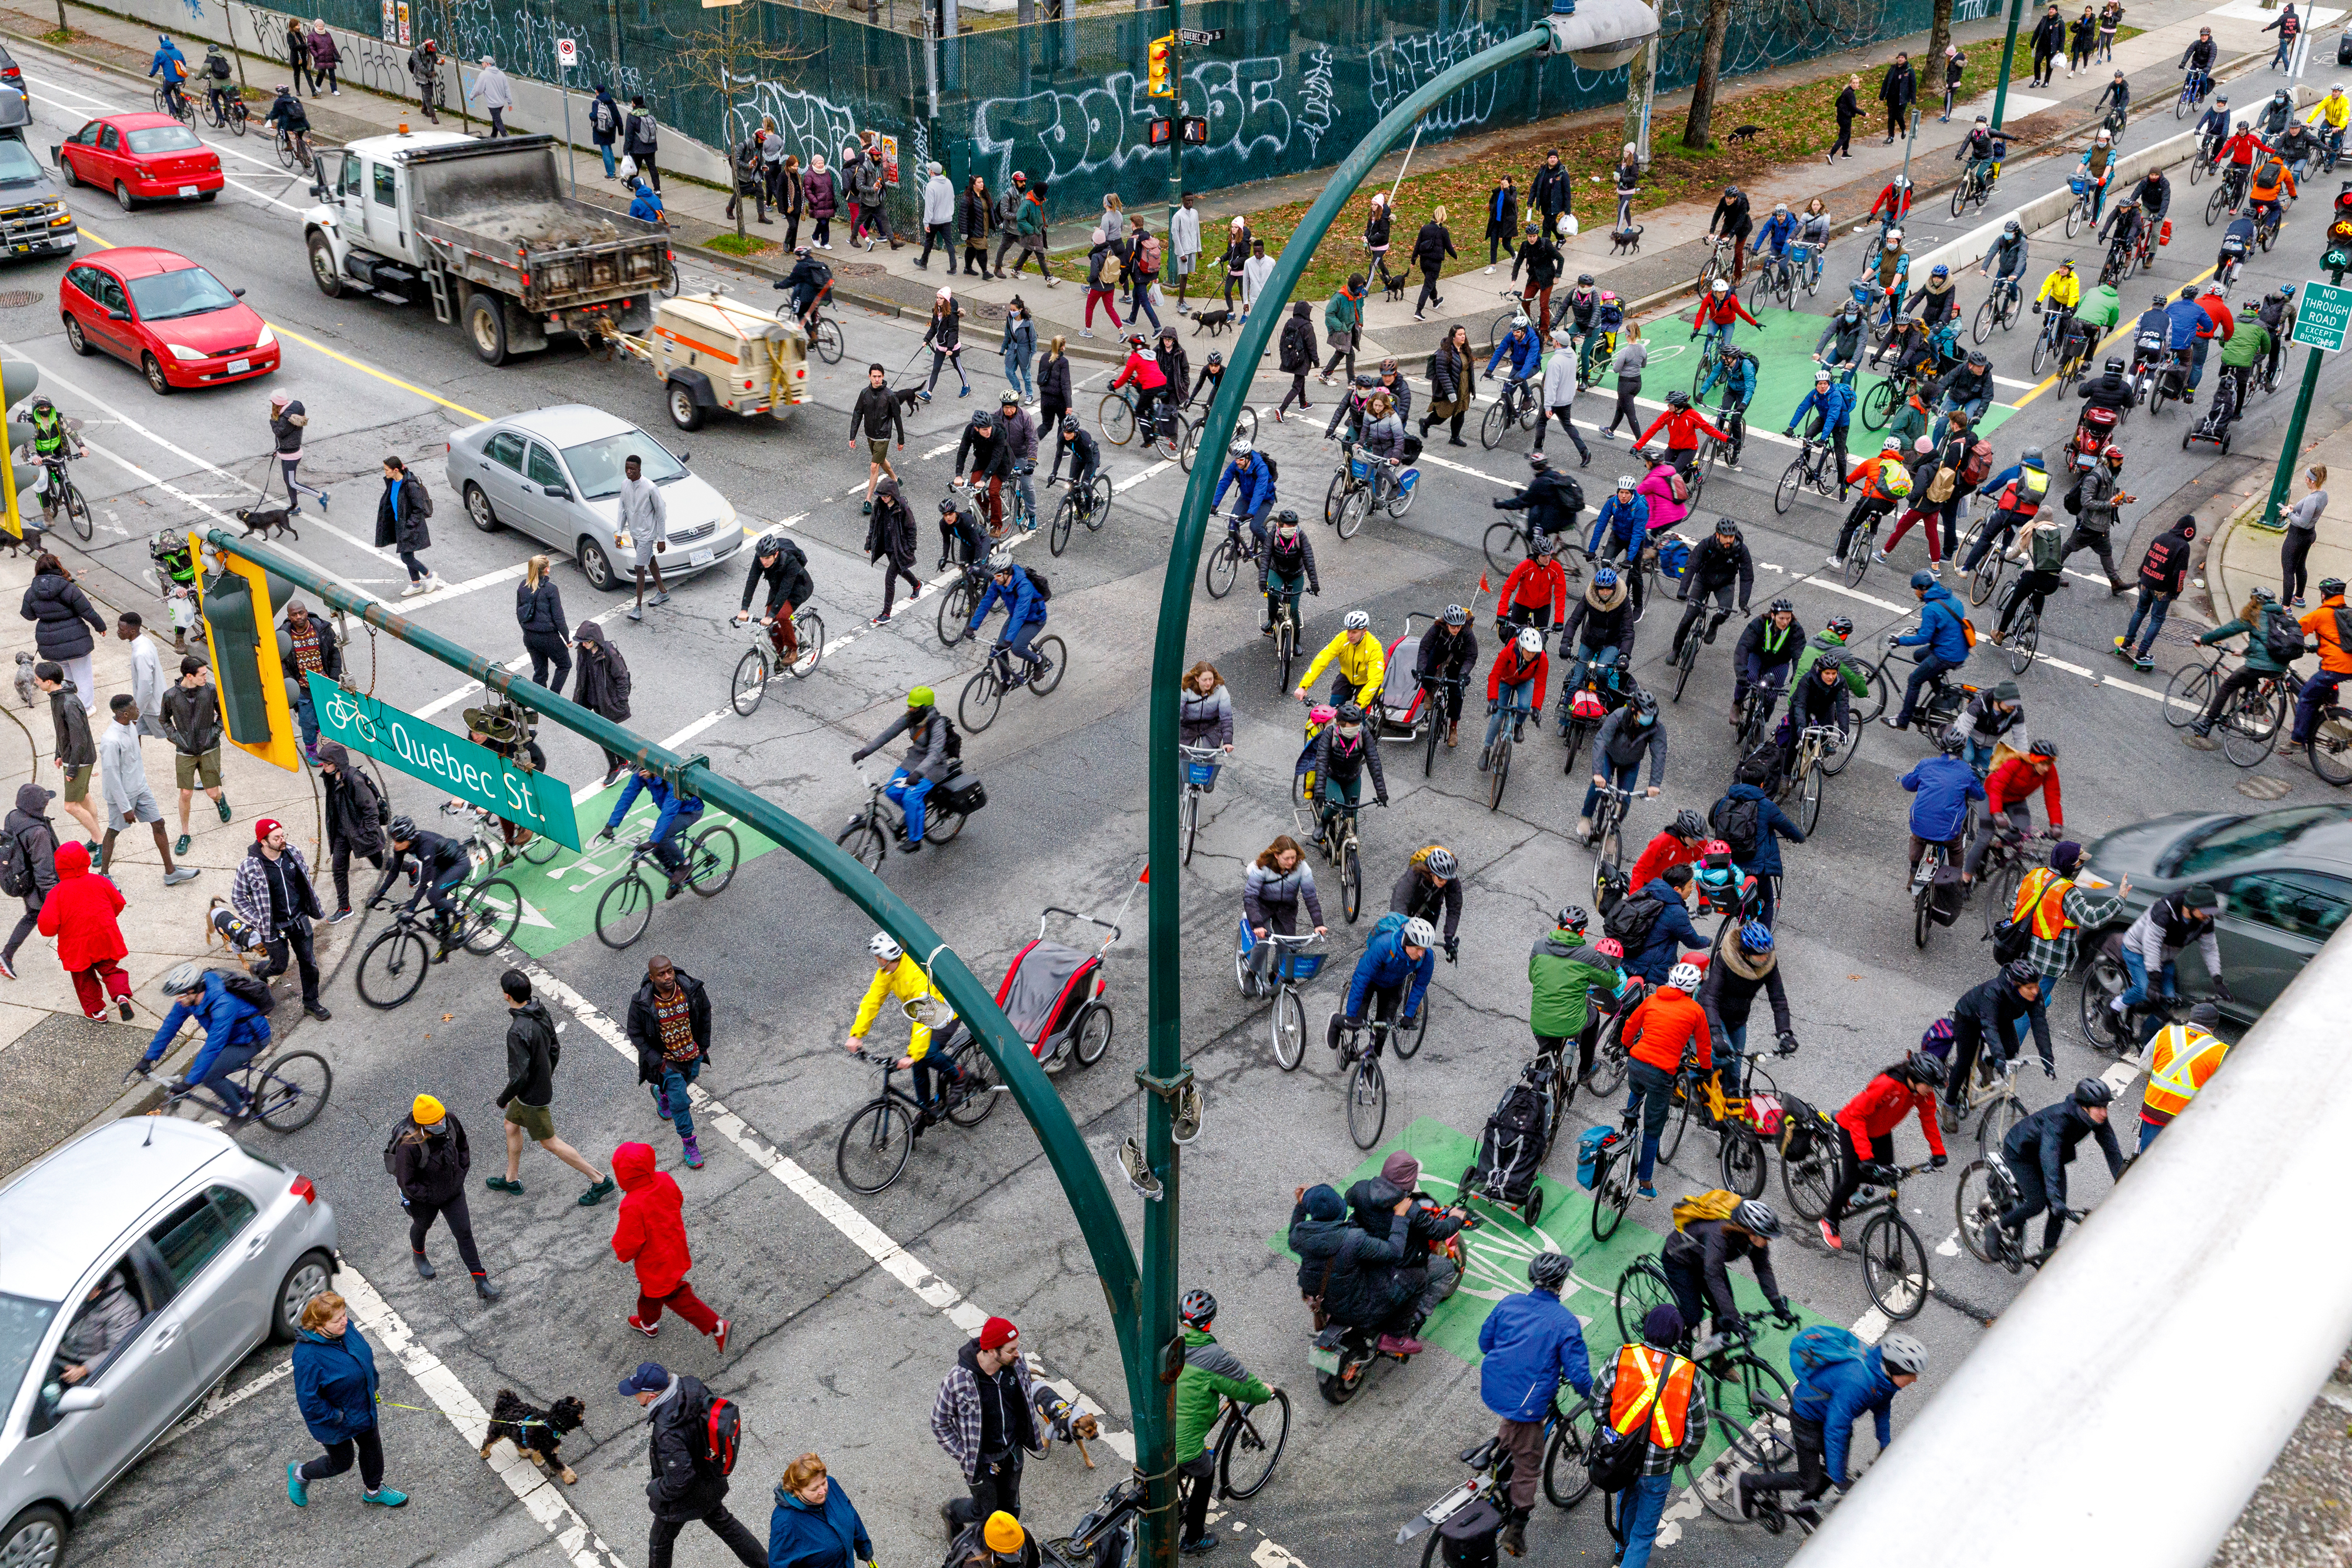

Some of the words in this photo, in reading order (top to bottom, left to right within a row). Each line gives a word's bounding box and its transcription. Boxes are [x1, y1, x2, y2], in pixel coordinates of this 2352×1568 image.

[1184, 31, 1201, 42] QUEBEC
[1164, 121, 1170, 138] 9
[2322, 288, 2337, 300] NO
[2306, 297, 2349, 316] THROUGH
[2308, 312, 2337, 326] ROAD
[2305, 326, 2333, 338] EXCEPT
[2153, 543, 2169, 555] FROM
[2150, 560, 2158, 569] TO
[392, 723, 496, 798] Quebec
[503, 773, 546, 823] St.
